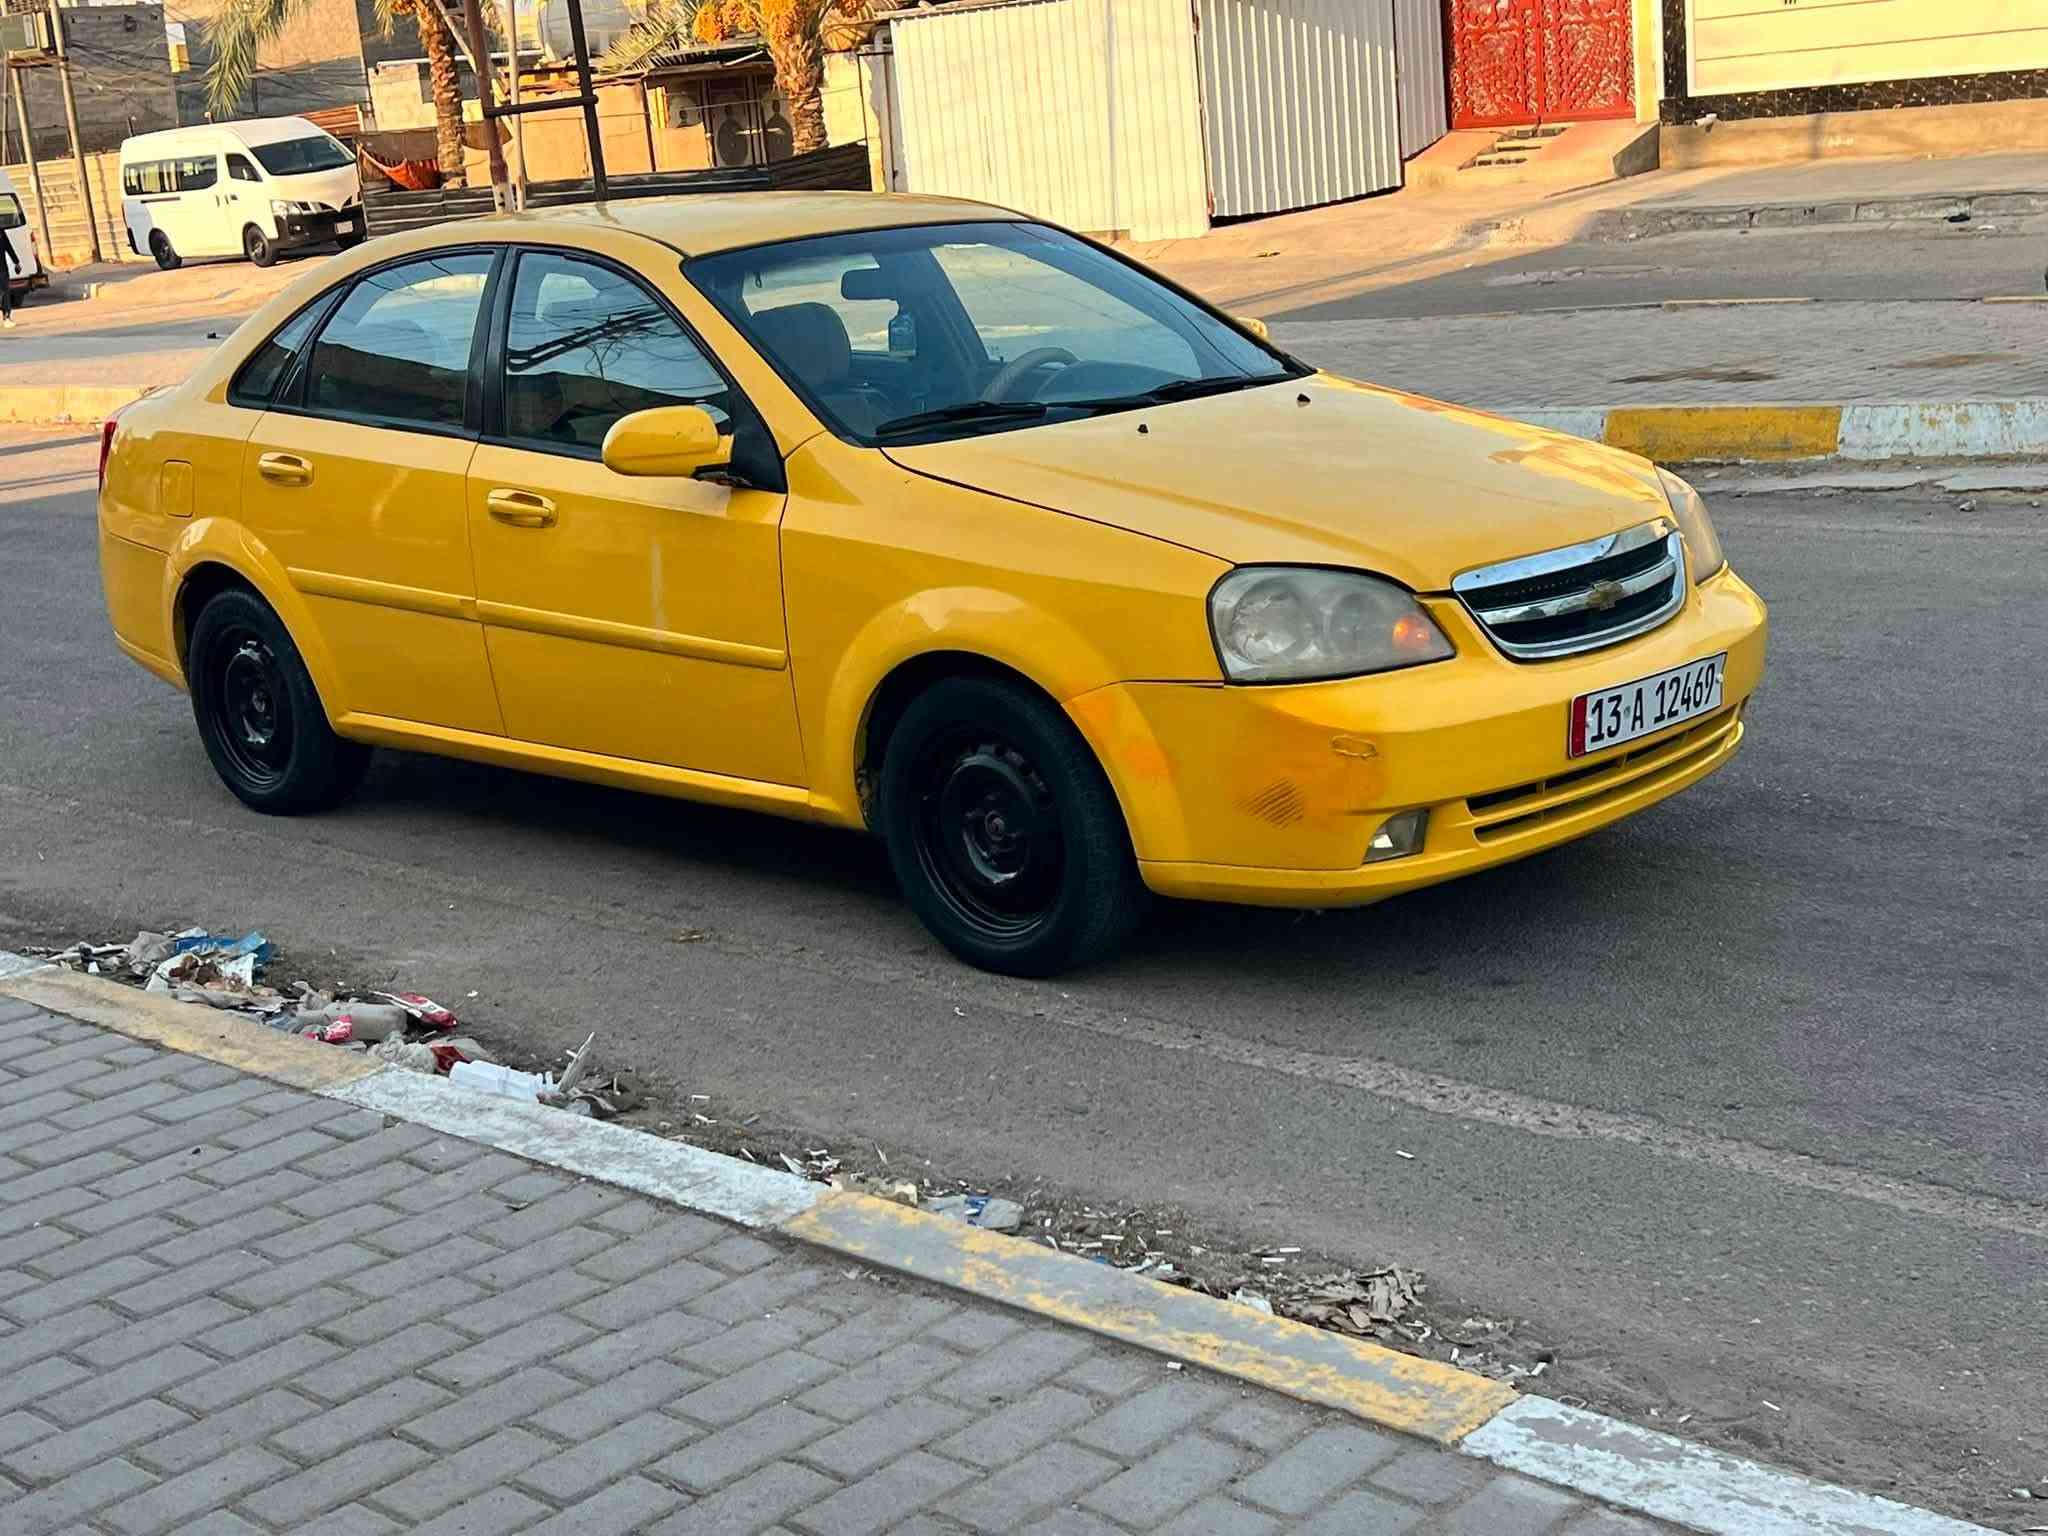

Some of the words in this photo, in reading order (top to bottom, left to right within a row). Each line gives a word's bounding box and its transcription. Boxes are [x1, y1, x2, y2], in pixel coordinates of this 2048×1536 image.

[1590, 694, 1622, 743] 13
[1631, 688, 1644, 731] A
[1654, 663, 1715, 723] 12469
